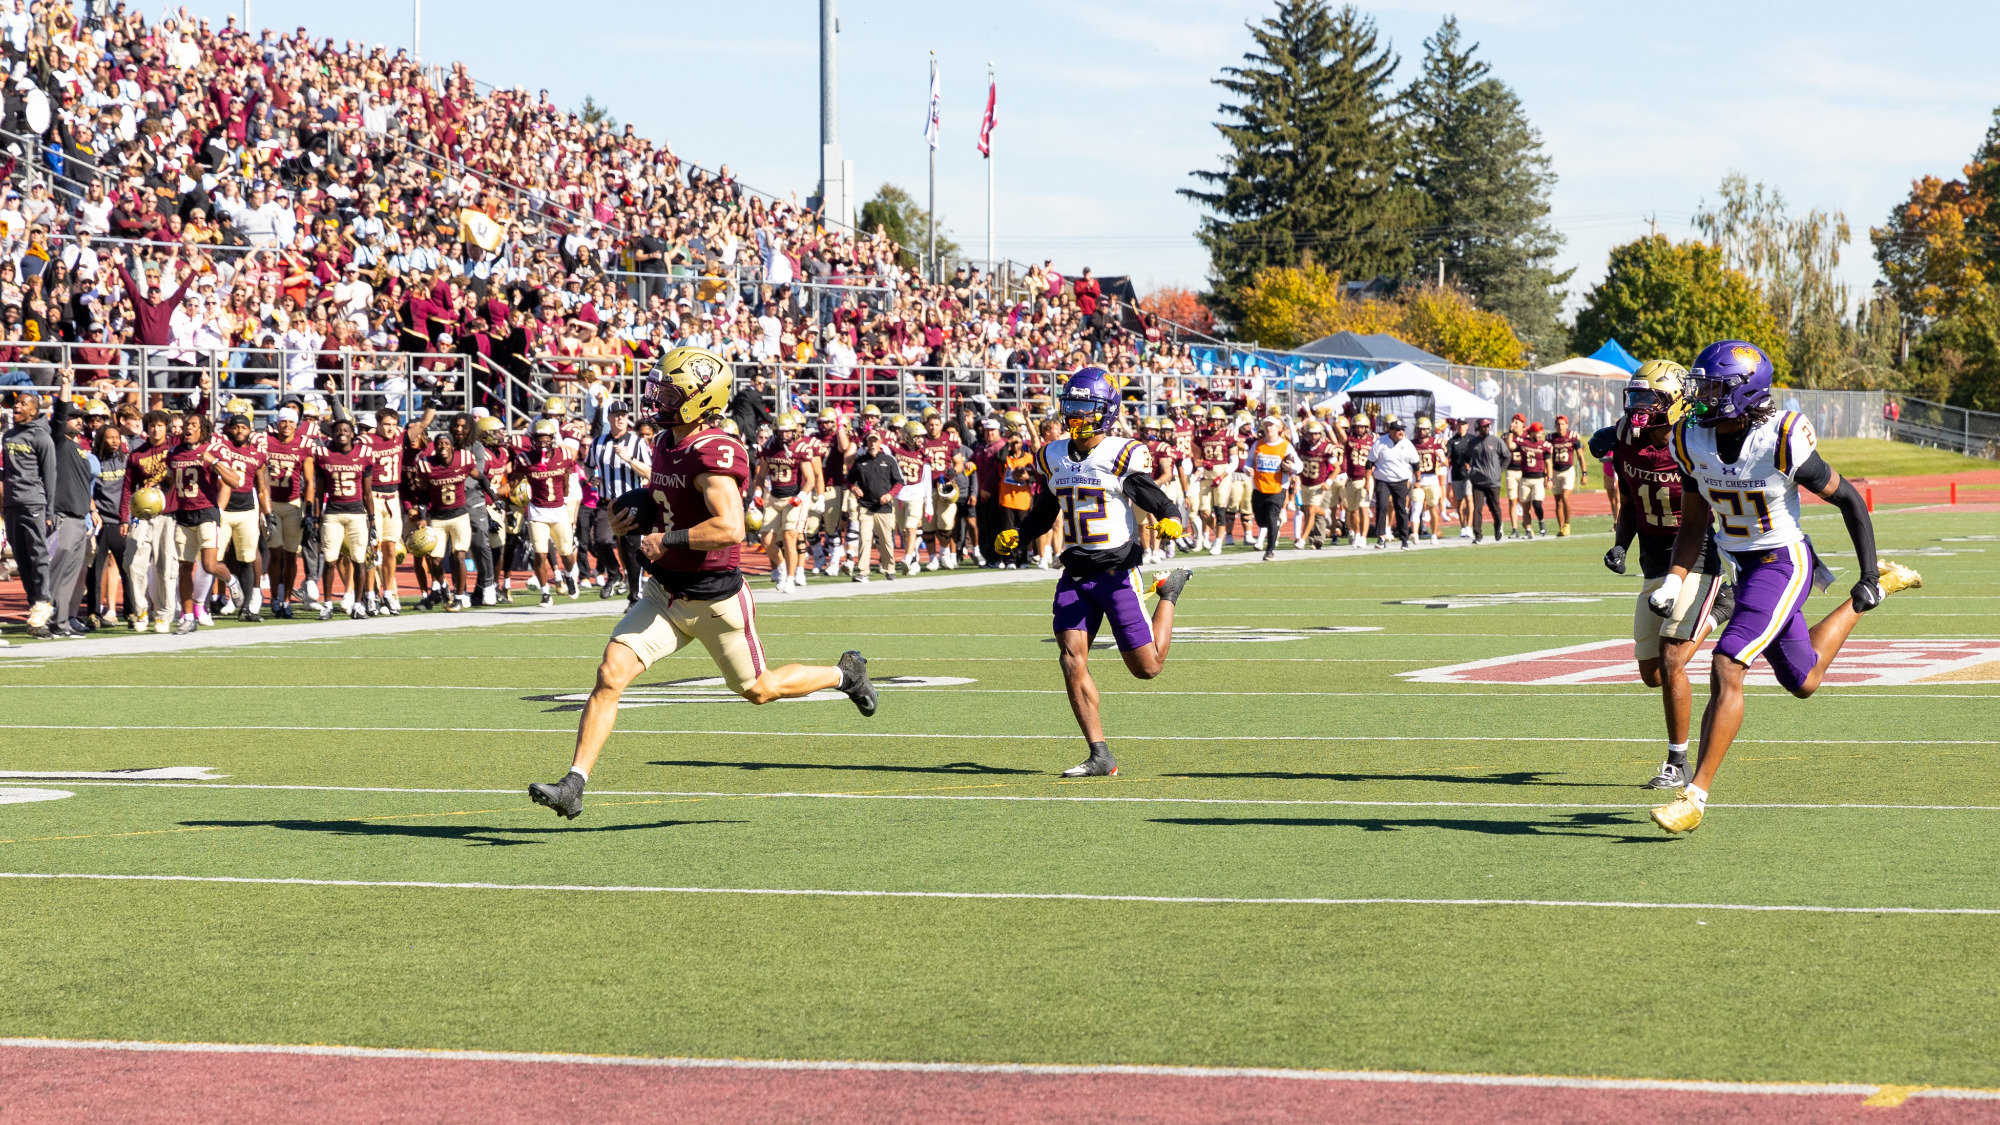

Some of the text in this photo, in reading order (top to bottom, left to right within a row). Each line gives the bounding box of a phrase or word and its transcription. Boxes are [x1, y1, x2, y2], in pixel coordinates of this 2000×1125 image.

[379, 453, 399, 482] 31
[716, 445, 734, 468] 3
[768, 463, 793, 483] 30
[1055, 476, 1102, 486] WEST CHESTER
[1623, 460, 1682, 483] KUTZTOW
[1703, 477, 1767, 488] WEST CHESTER
[332, 471, 356, 497] 15
[441, 483, 456, 506] 6
[545, 477, 556, 502] 1
[1054, 486, 1110, 545] 32
[1638, 484, 1679, 527] 11
[1708, 487, 1774, 538] 21
